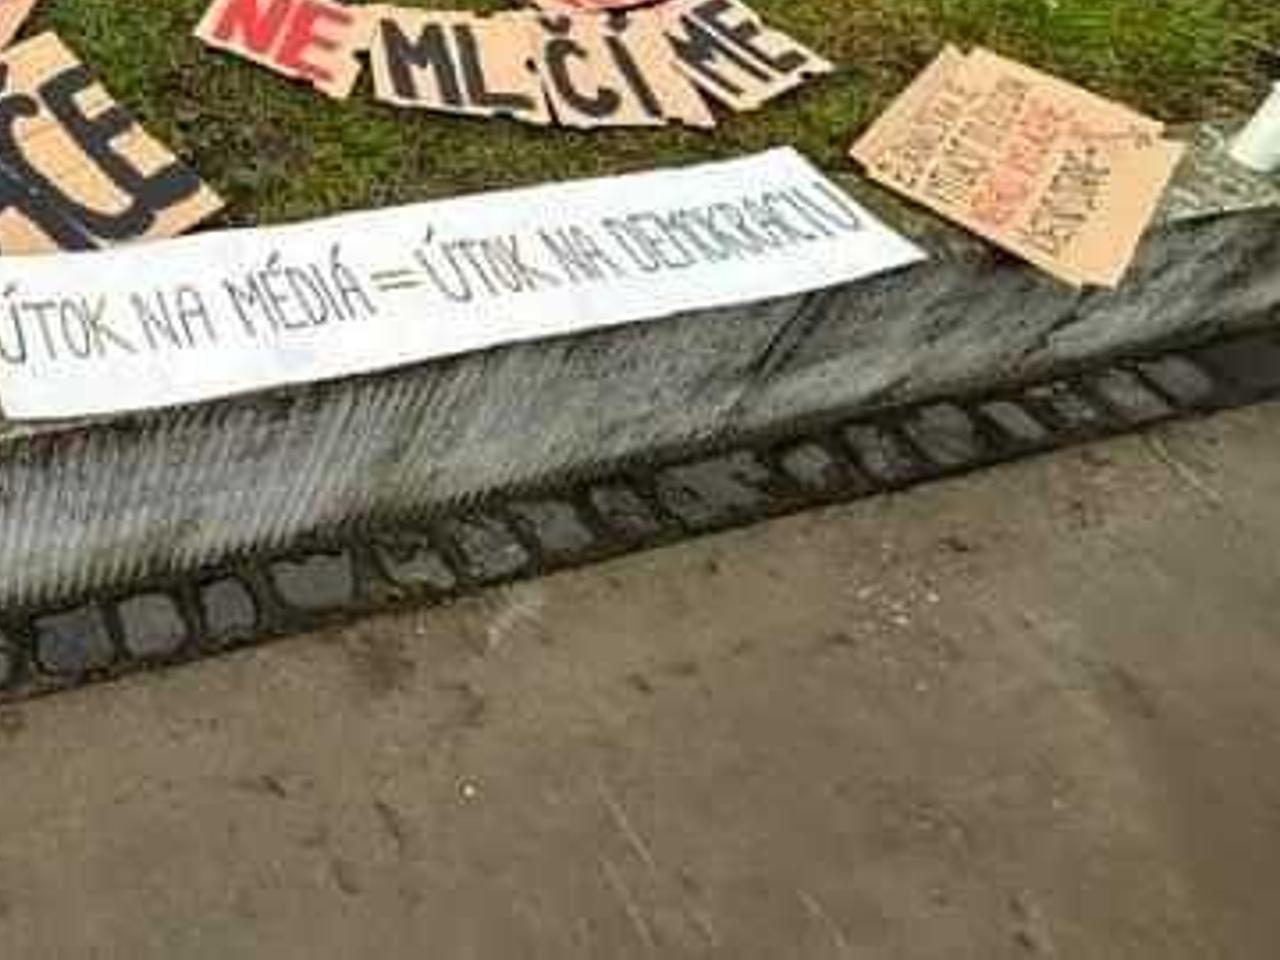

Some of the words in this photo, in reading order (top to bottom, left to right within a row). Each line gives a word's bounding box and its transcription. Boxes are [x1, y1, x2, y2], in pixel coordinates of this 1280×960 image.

[132, 286, 216, 348] NA
[223, 243, 378, 338] MÉDIÁ
[414, 223, 562, 303] ÚTOK
[538, 222, 620, 285] NA
